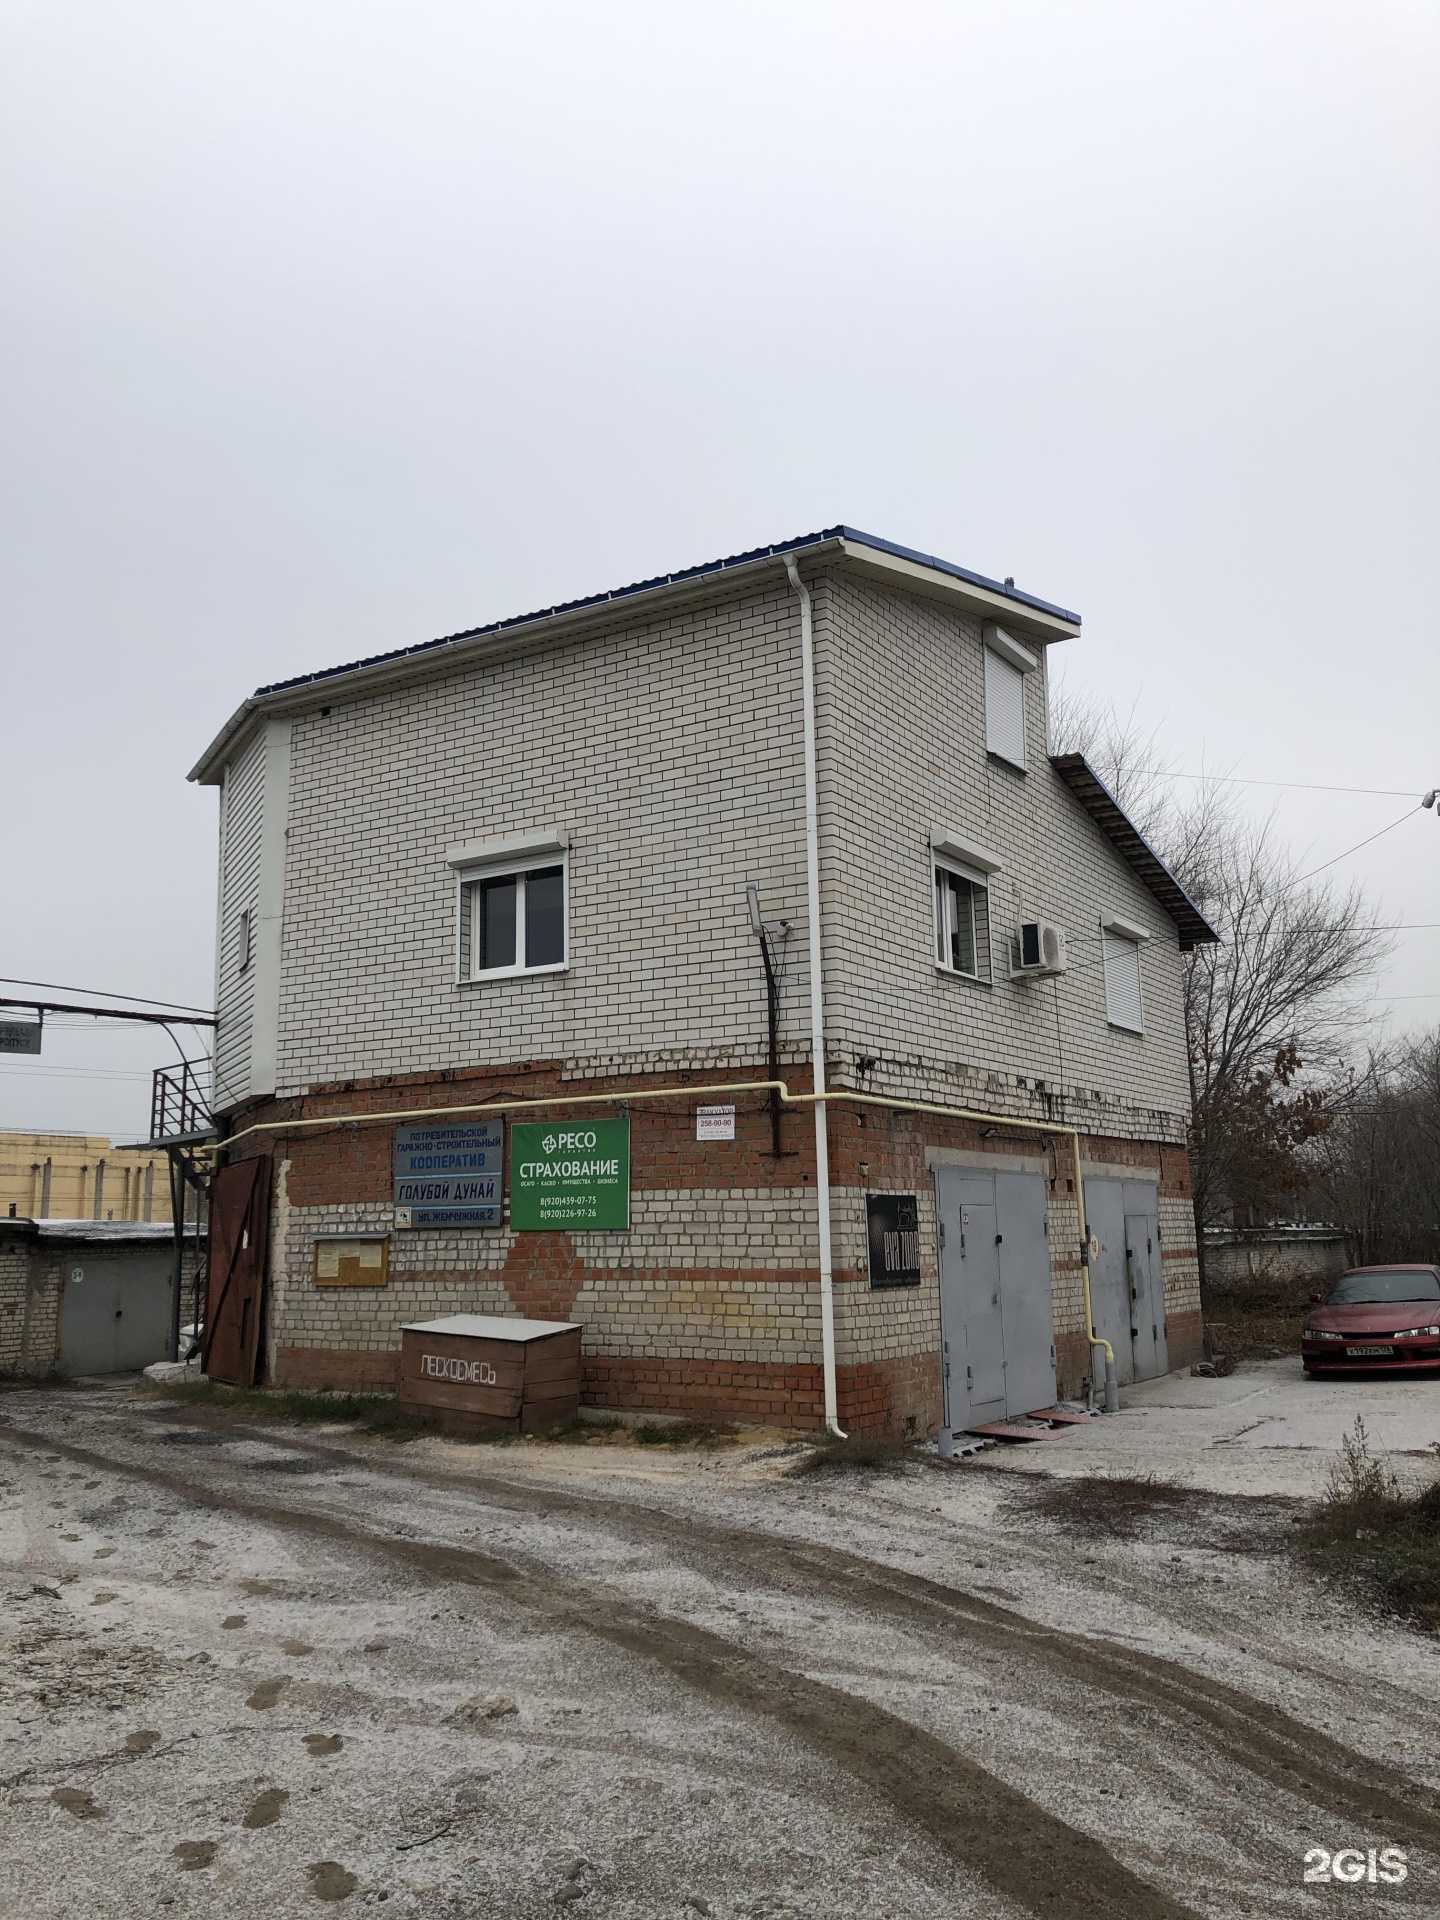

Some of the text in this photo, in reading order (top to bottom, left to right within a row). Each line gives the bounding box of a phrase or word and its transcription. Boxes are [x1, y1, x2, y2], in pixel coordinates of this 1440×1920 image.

[558, 1131, 597, 1150] РЕСО
[410, 1152, 486, 1169] КООПЕРАТИВ
[519, 1159, 620, 1178] СТРАХОВАНИЕ
[399, 1178, 495, 1201] ГОЛУБОЙ ДУНАЙ
[884, 1231, 920, 1272] eva zone
